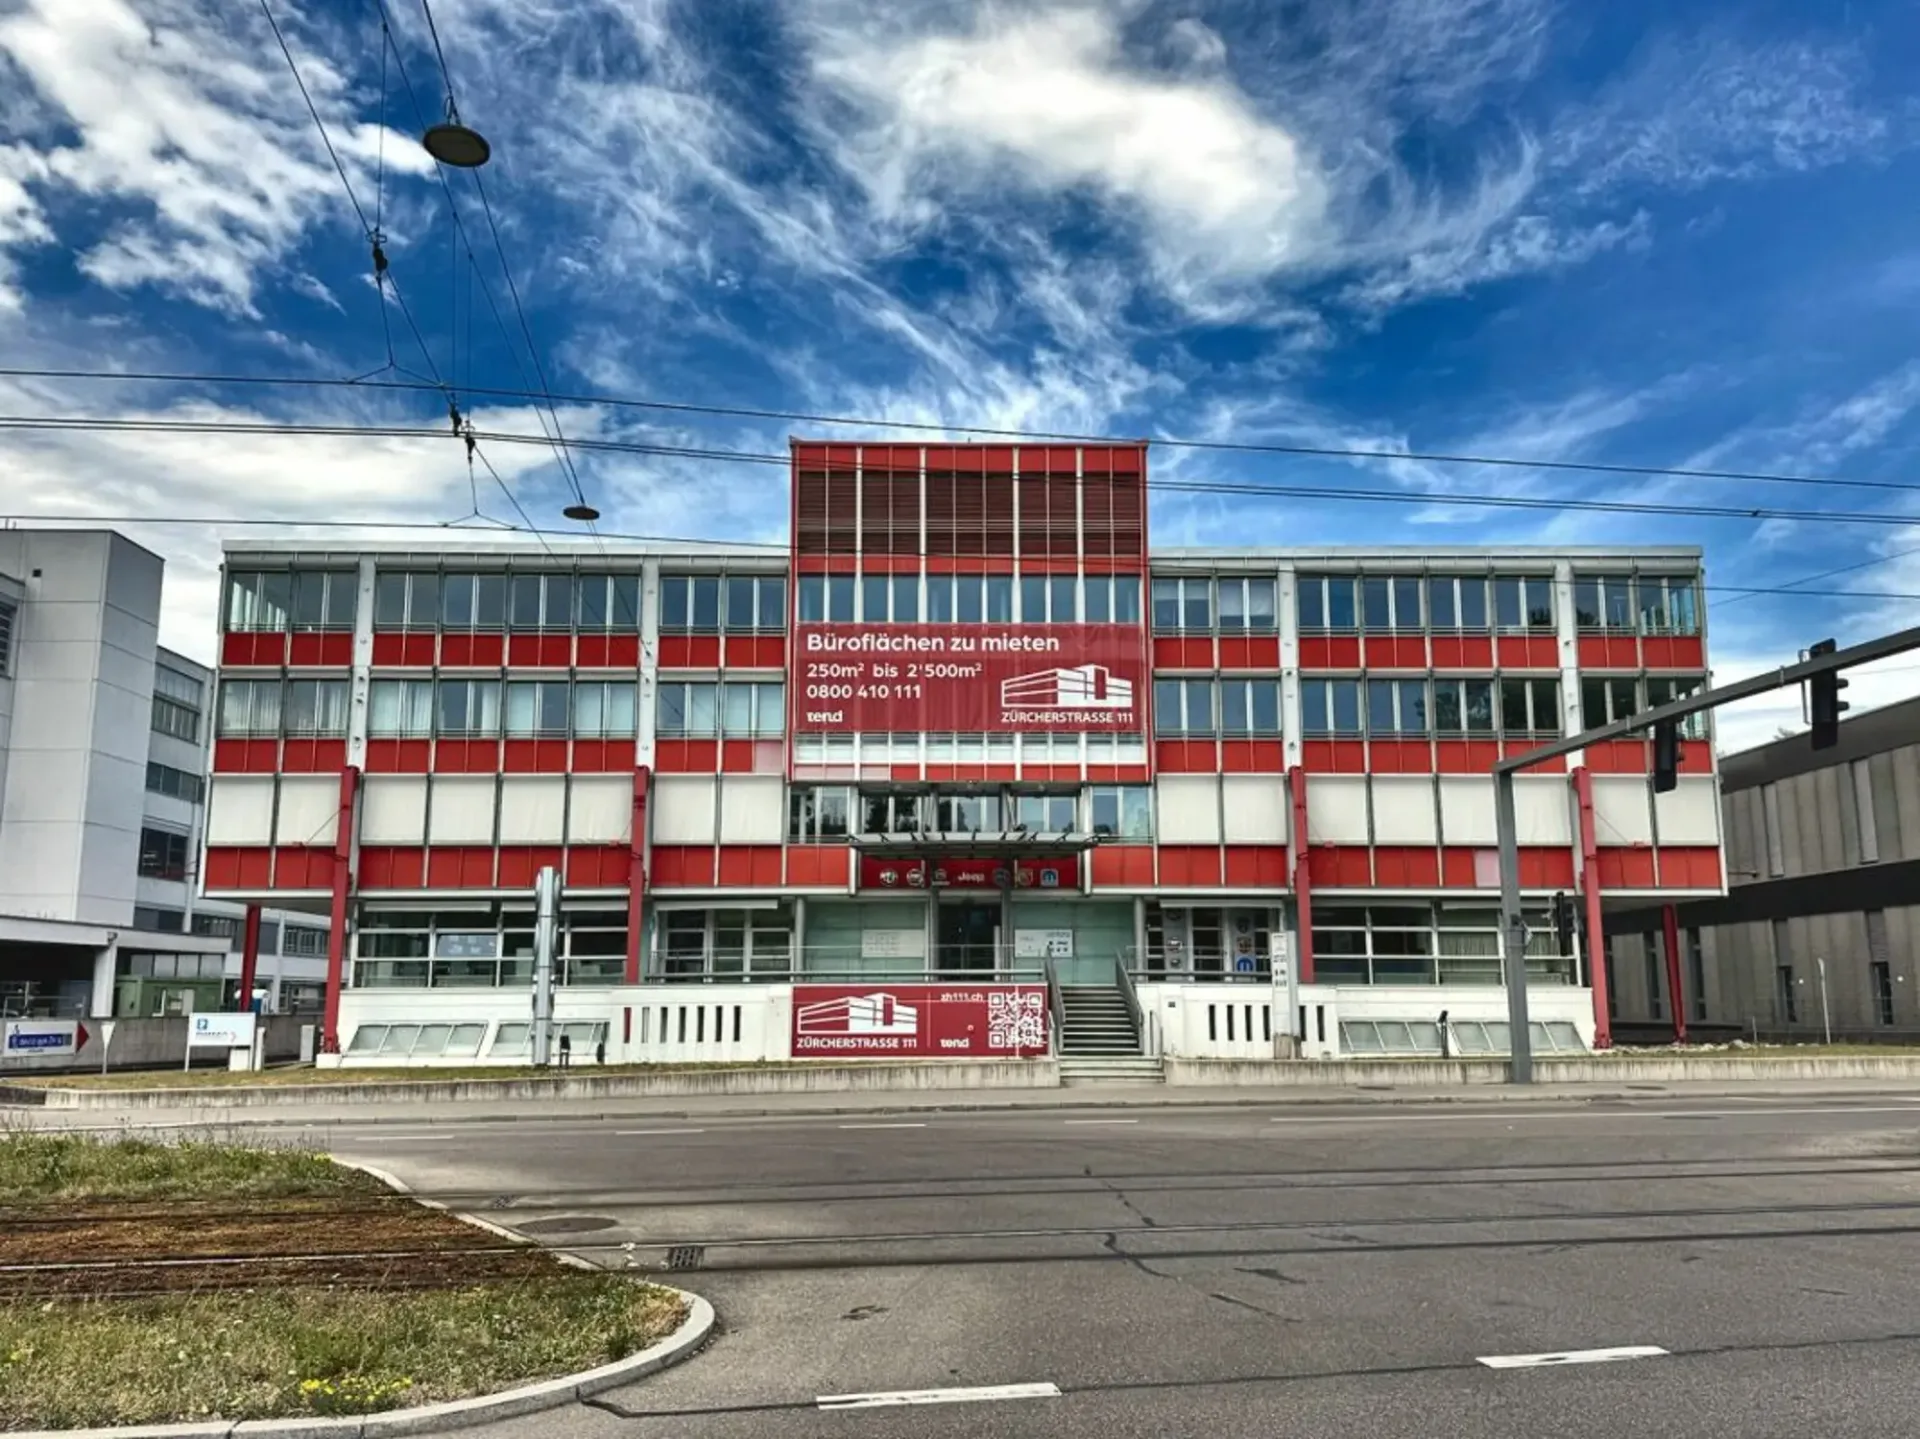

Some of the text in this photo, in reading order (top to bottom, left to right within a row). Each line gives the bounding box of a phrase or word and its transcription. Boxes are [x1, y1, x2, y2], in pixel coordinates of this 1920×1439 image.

[807, 633, 1060, 651] Büroflächen zu mieten
[872, 662, 898, 678] bis
[806, 684, 921, 699] 0800 410 111
[1001, 709, 1134, 724] ZÜRCHERSTRASSE 111
[957, 871, 985, 883] Jeep
[940, 992, 984, 1003] zh111.ch
[796, 1036, 917, 1049] ZÜRCHERSTRASSE 111
